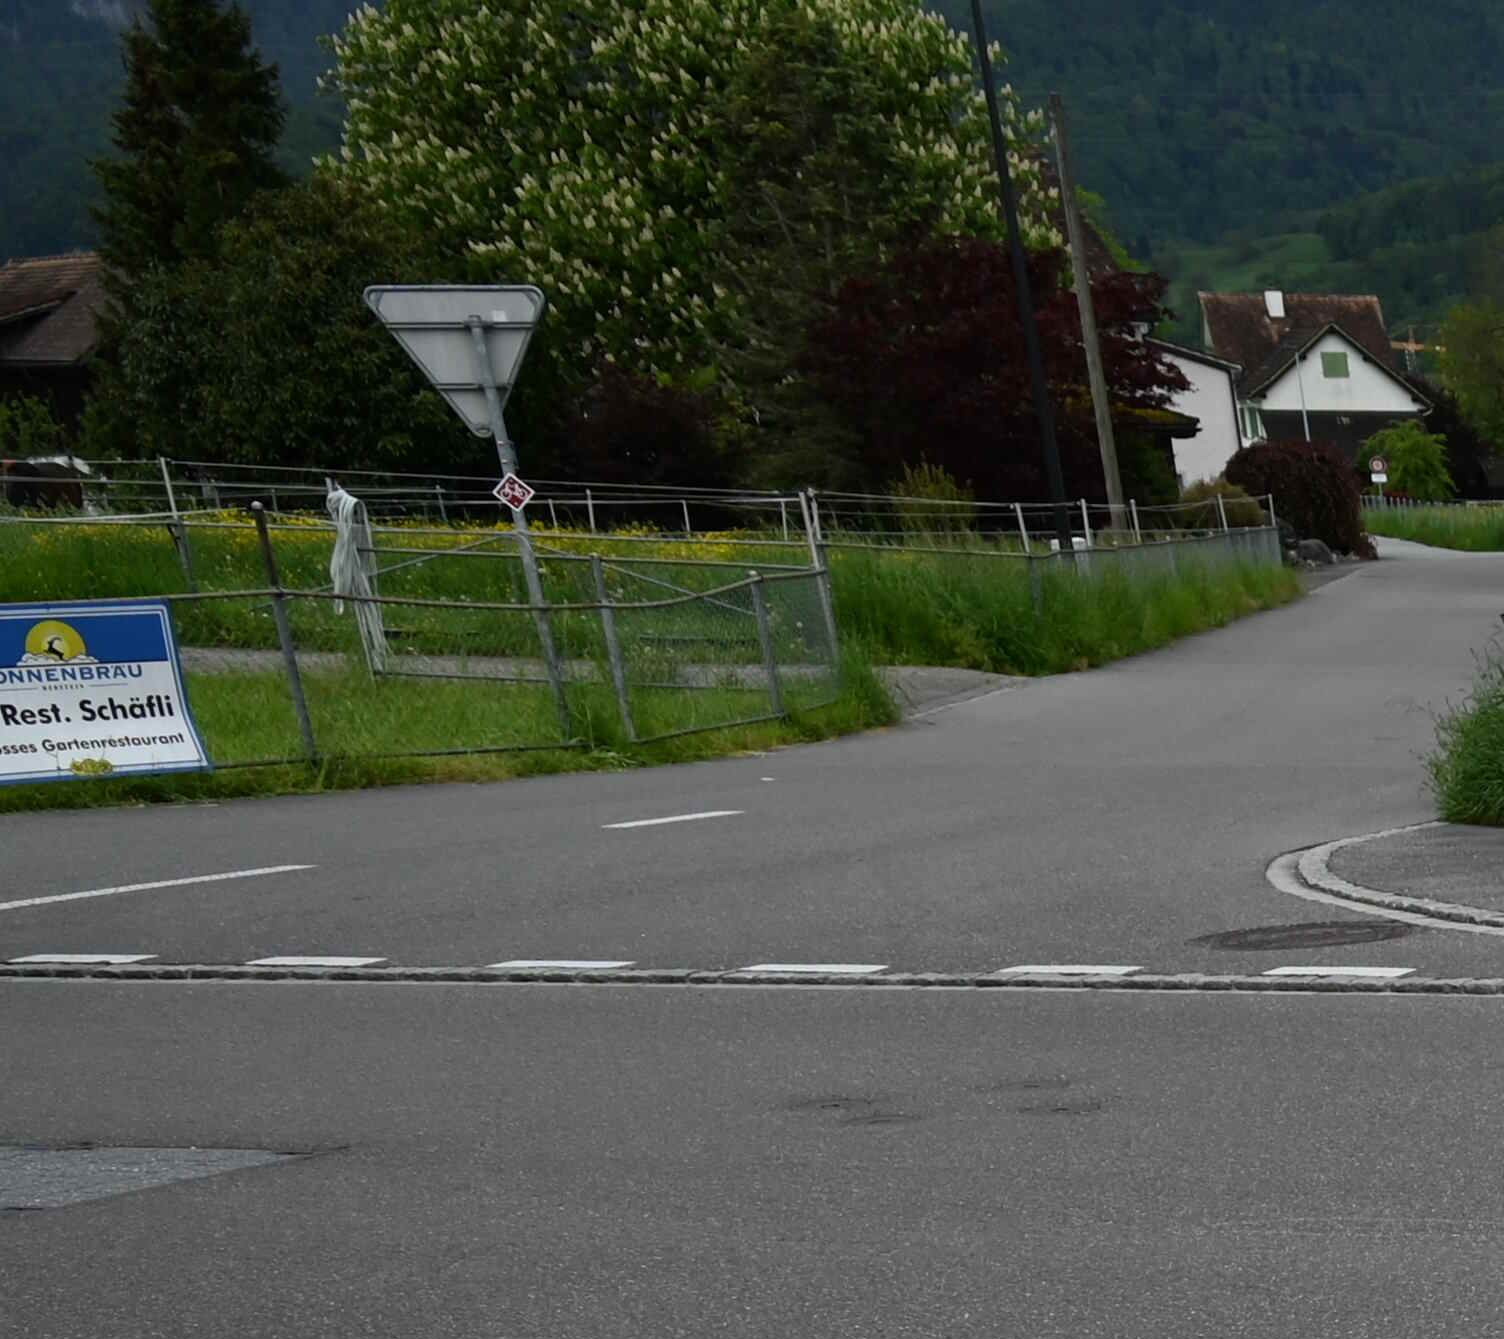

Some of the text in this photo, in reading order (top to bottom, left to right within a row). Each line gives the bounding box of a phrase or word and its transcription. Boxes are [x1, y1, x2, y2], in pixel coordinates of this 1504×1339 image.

[0, 695, 175, 726] Rest. Schäfli
[0, 732, 185, 756] sses Gartenrestaurant
